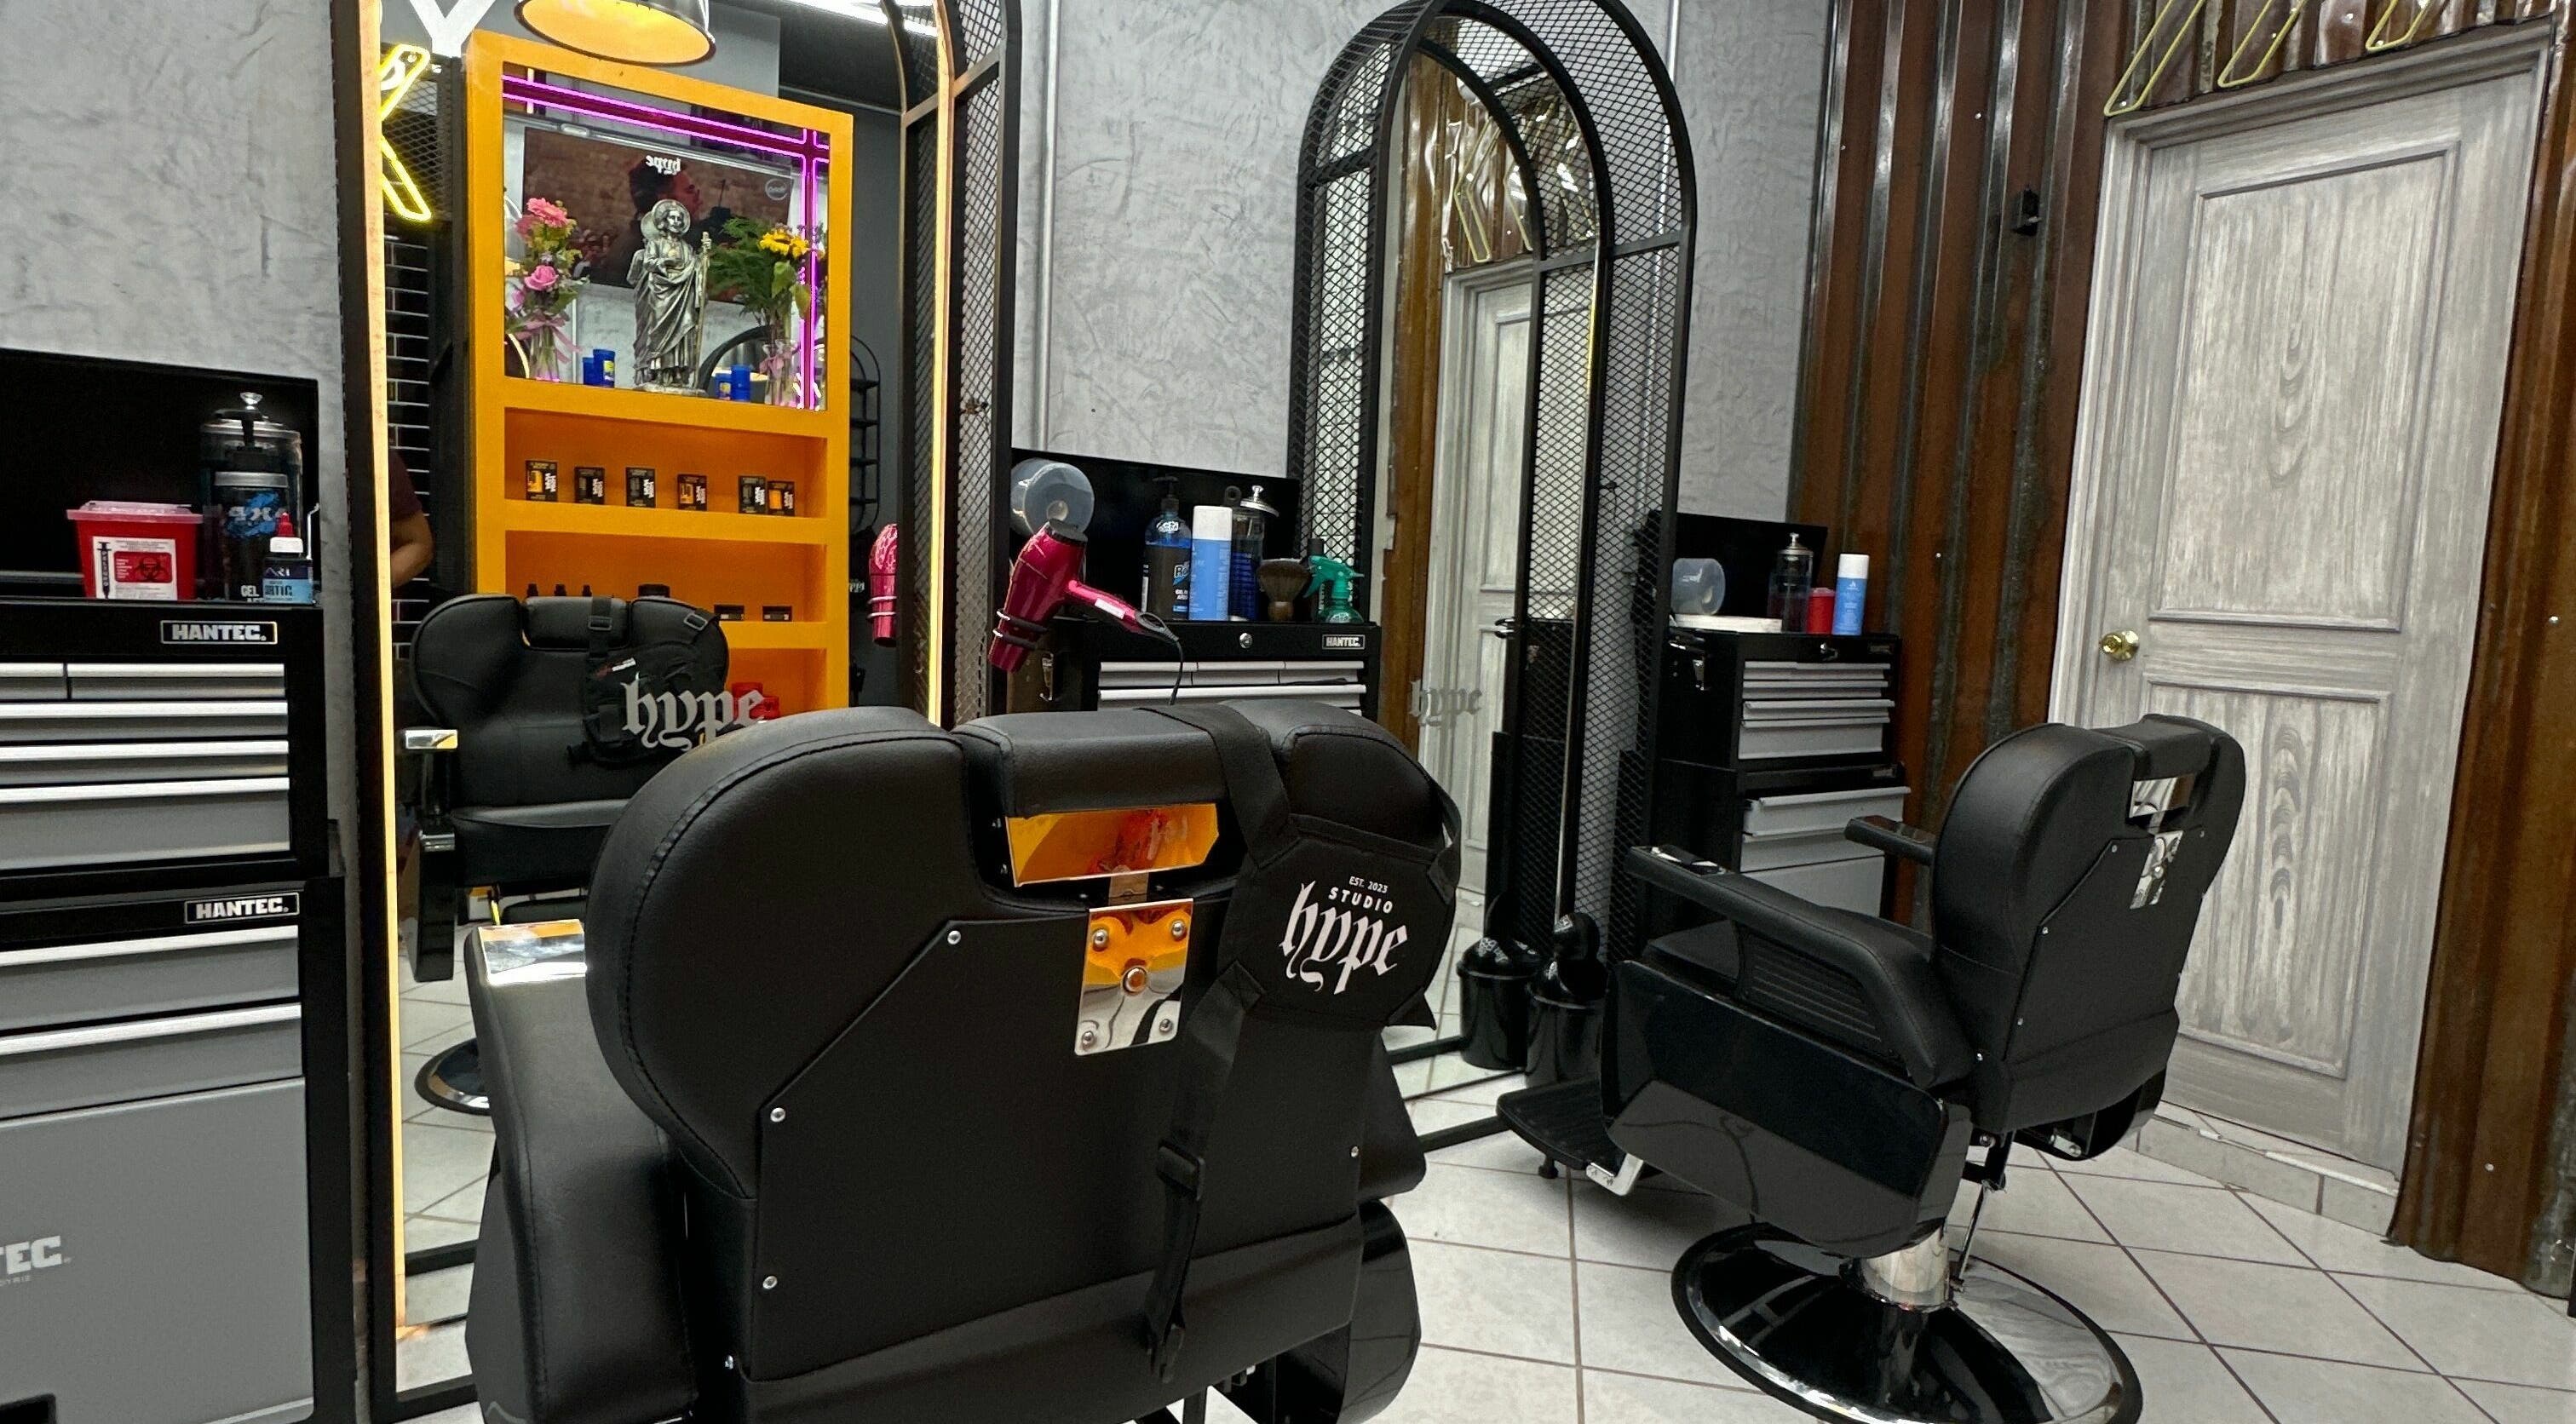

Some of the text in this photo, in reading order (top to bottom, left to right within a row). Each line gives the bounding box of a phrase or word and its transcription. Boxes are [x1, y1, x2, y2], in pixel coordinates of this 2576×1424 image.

[620, 672, 766, 752] hype
[1279, 881, 1407, 995] hype
[1328, 887, 1394, 914] STUDIO
